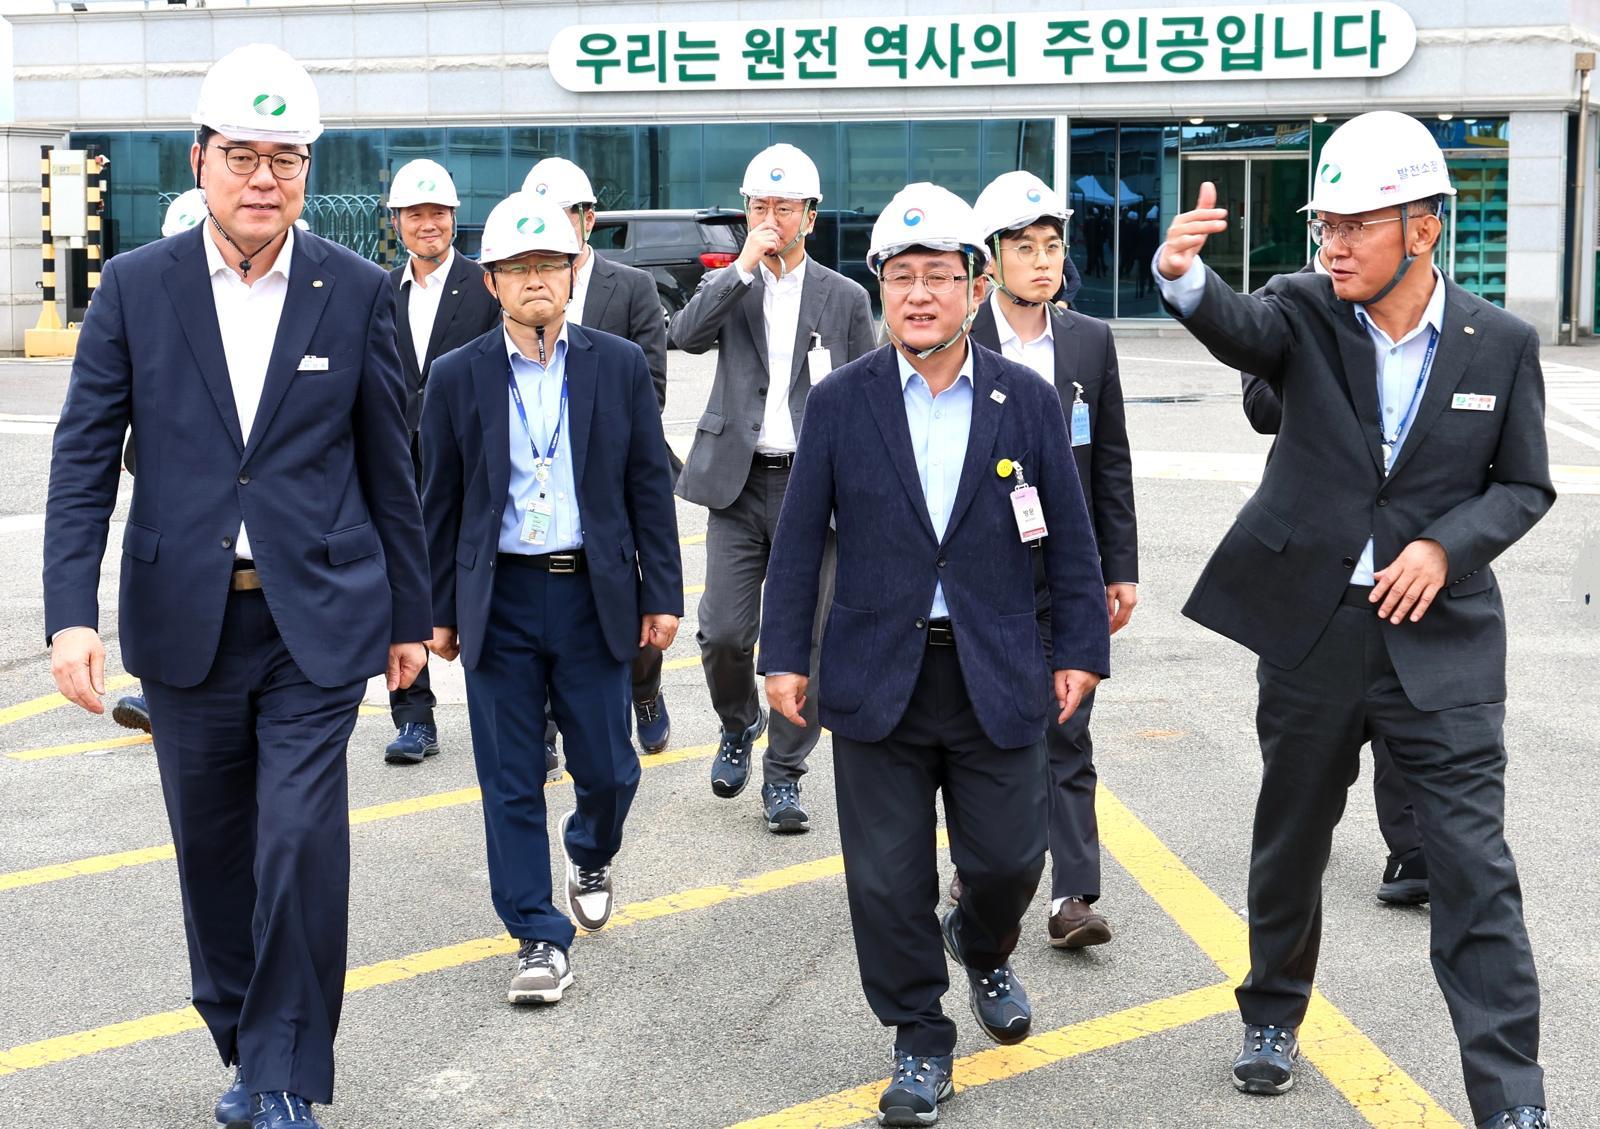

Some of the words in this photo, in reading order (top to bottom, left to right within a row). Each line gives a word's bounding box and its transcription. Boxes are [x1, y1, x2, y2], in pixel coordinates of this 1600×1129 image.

[576, 30, 720, 84] 우리는
[742, 26, 838, 80] 원전
[864, 21, 1016, 79] 역사의
[1043, 9, 1387, 75] 주인공입니다
[1397, 161, 1438, 180] 발전소장
